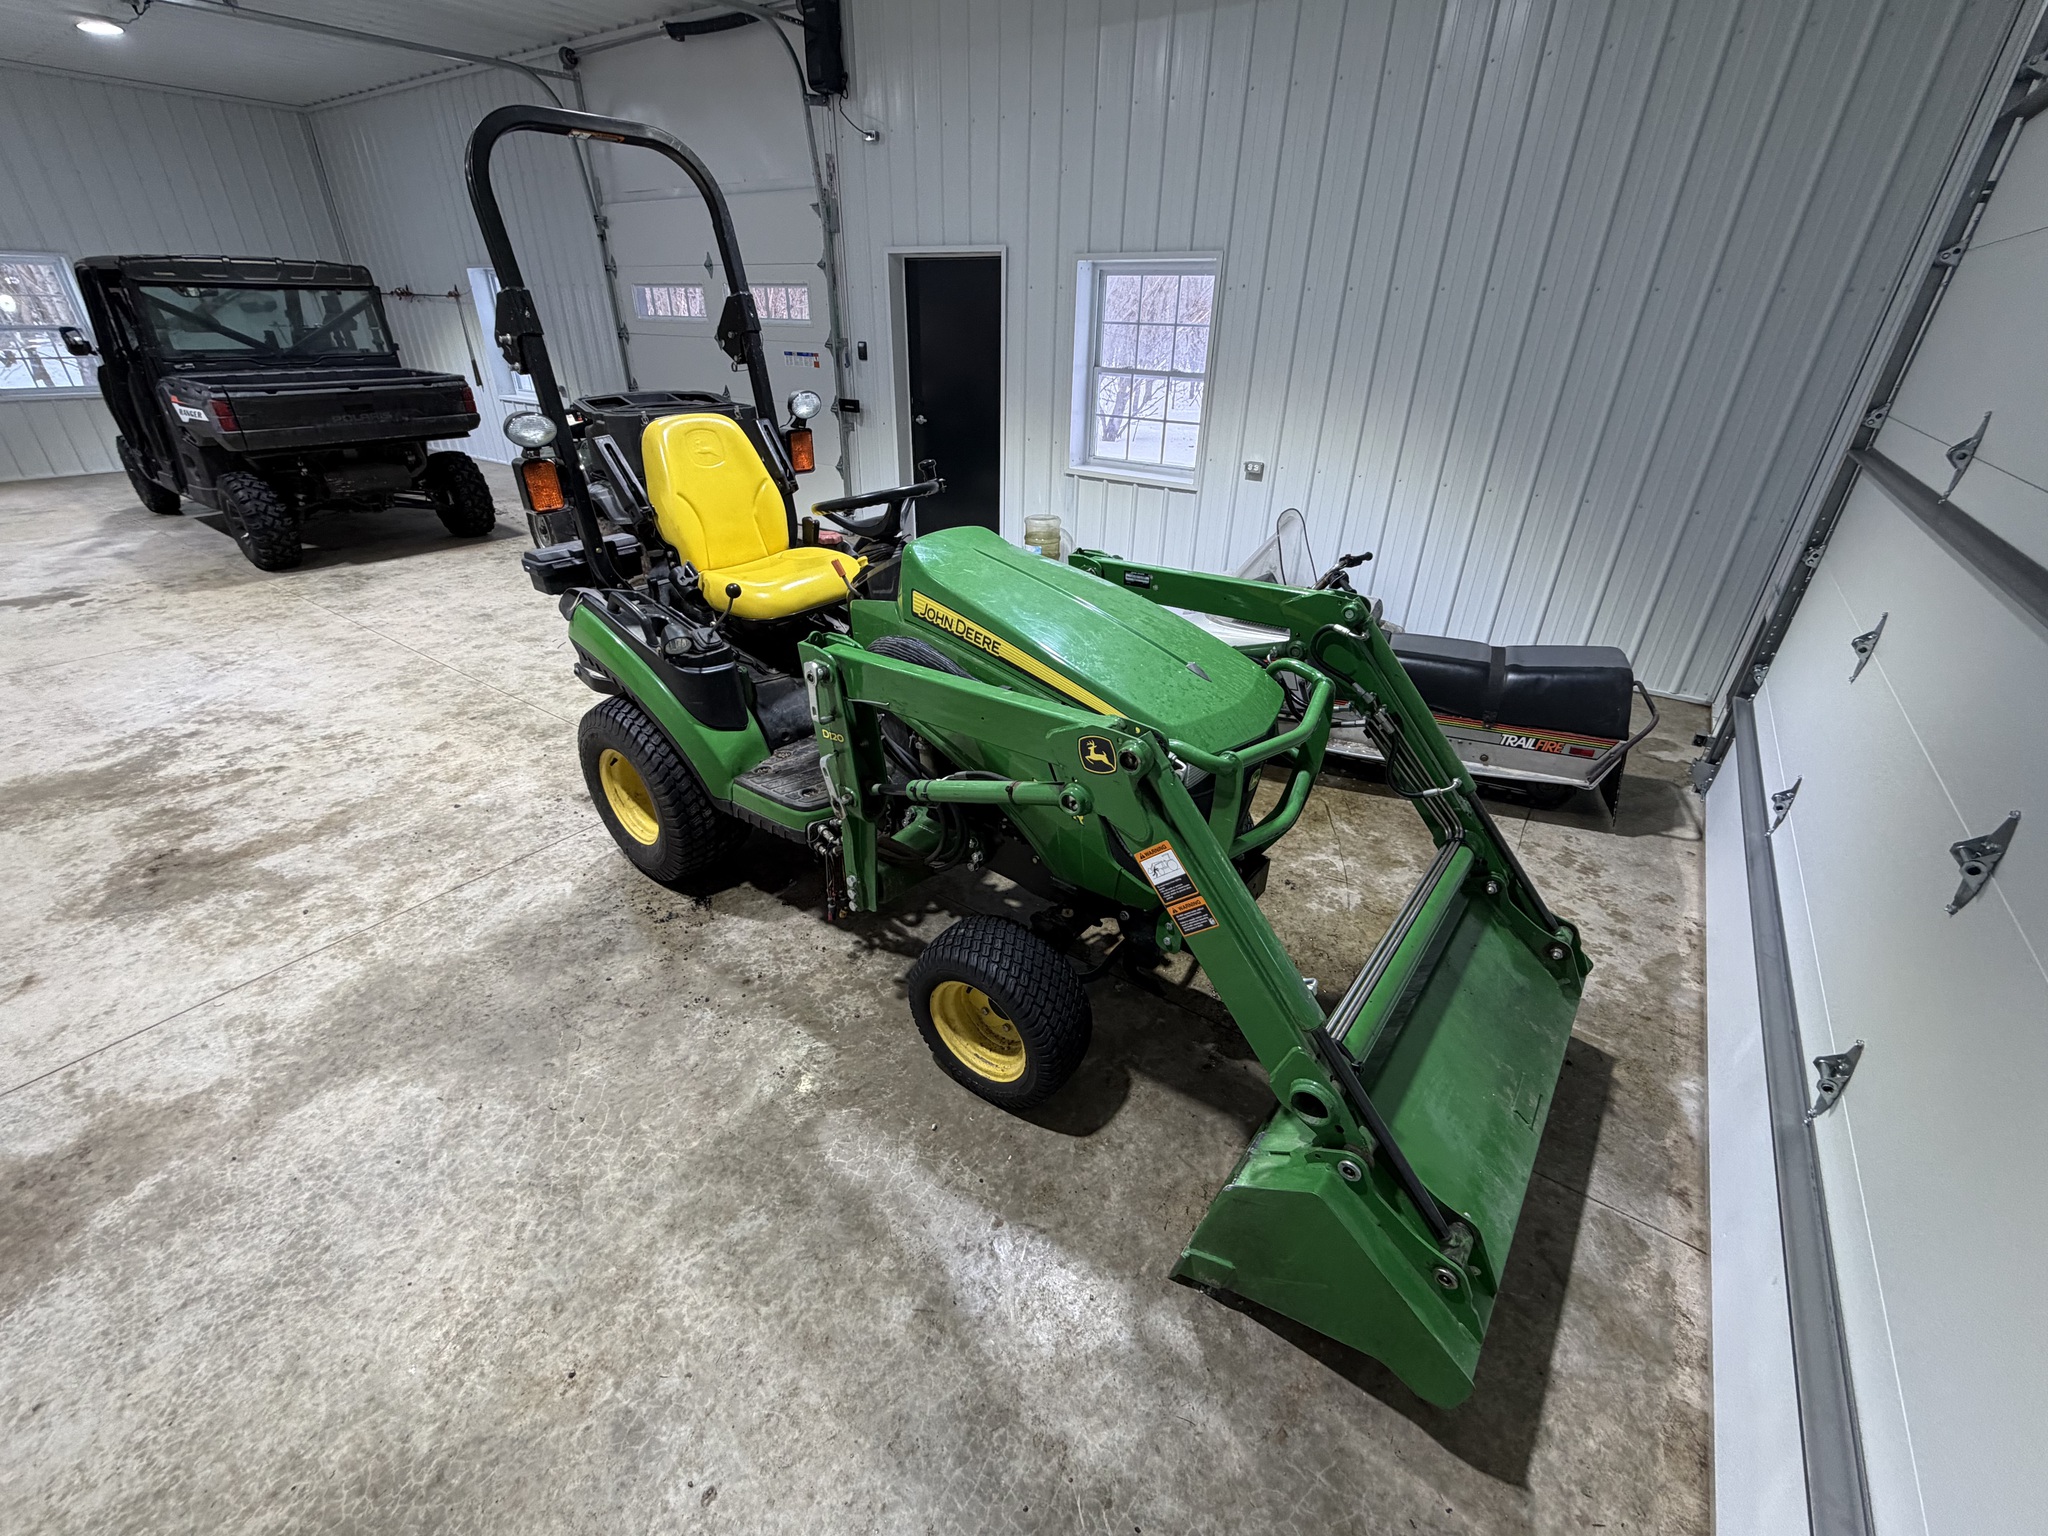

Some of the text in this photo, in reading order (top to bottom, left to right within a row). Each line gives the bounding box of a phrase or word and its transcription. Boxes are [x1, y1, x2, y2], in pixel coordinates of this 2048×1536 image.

[178, 408, 203, 419] RANGER
[332, 411, 393, 424] POLARIS
[919, 603, 1002, 655] JOHN DEERE
[821, 728, 845, 743] D120
[1144, 844, 1168, 857] WARNING
[1178, 899, 1202, 911] WARNING
